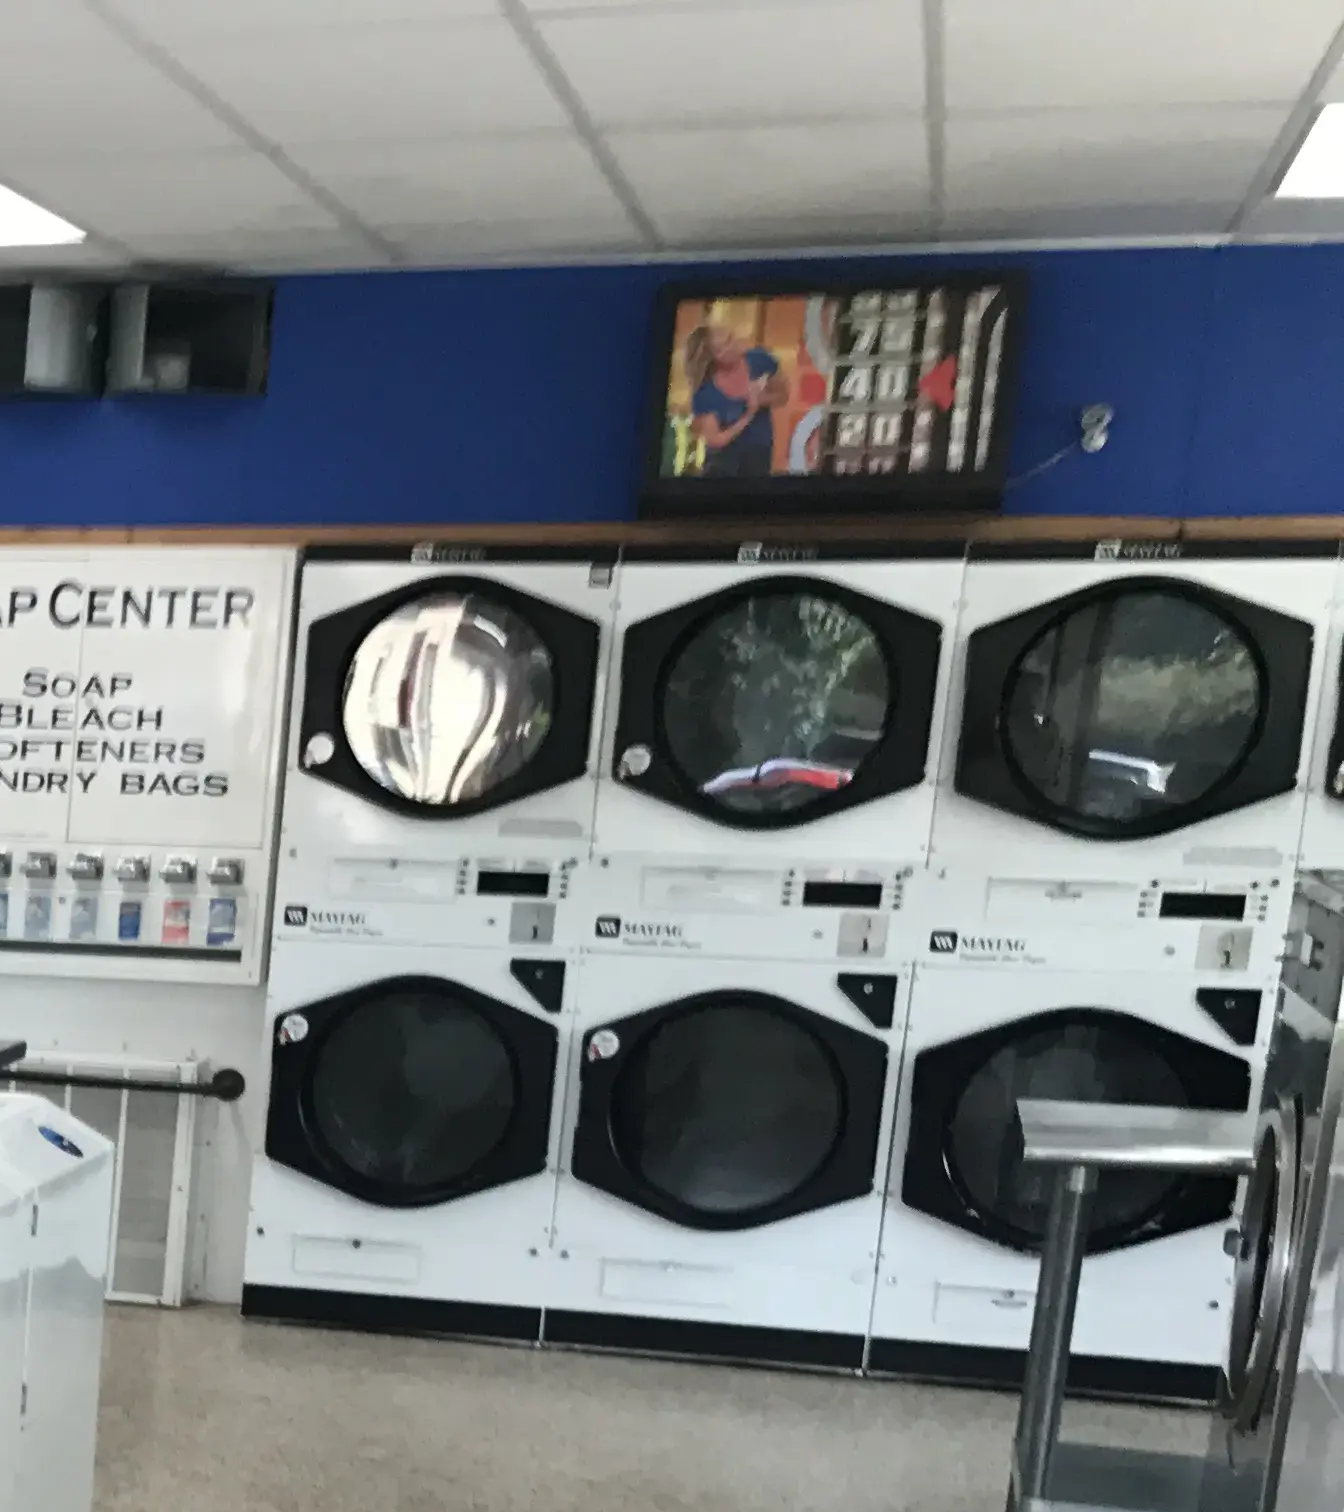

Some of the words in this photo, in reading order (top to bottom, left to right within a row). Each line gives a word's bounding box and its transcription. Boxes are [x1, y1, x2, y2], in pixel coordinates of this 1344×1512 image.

[48, 579, 255, 630] CENTER
[22, 667, 133, 699] SOAP
[119, 772, 230, 798] BAGS
